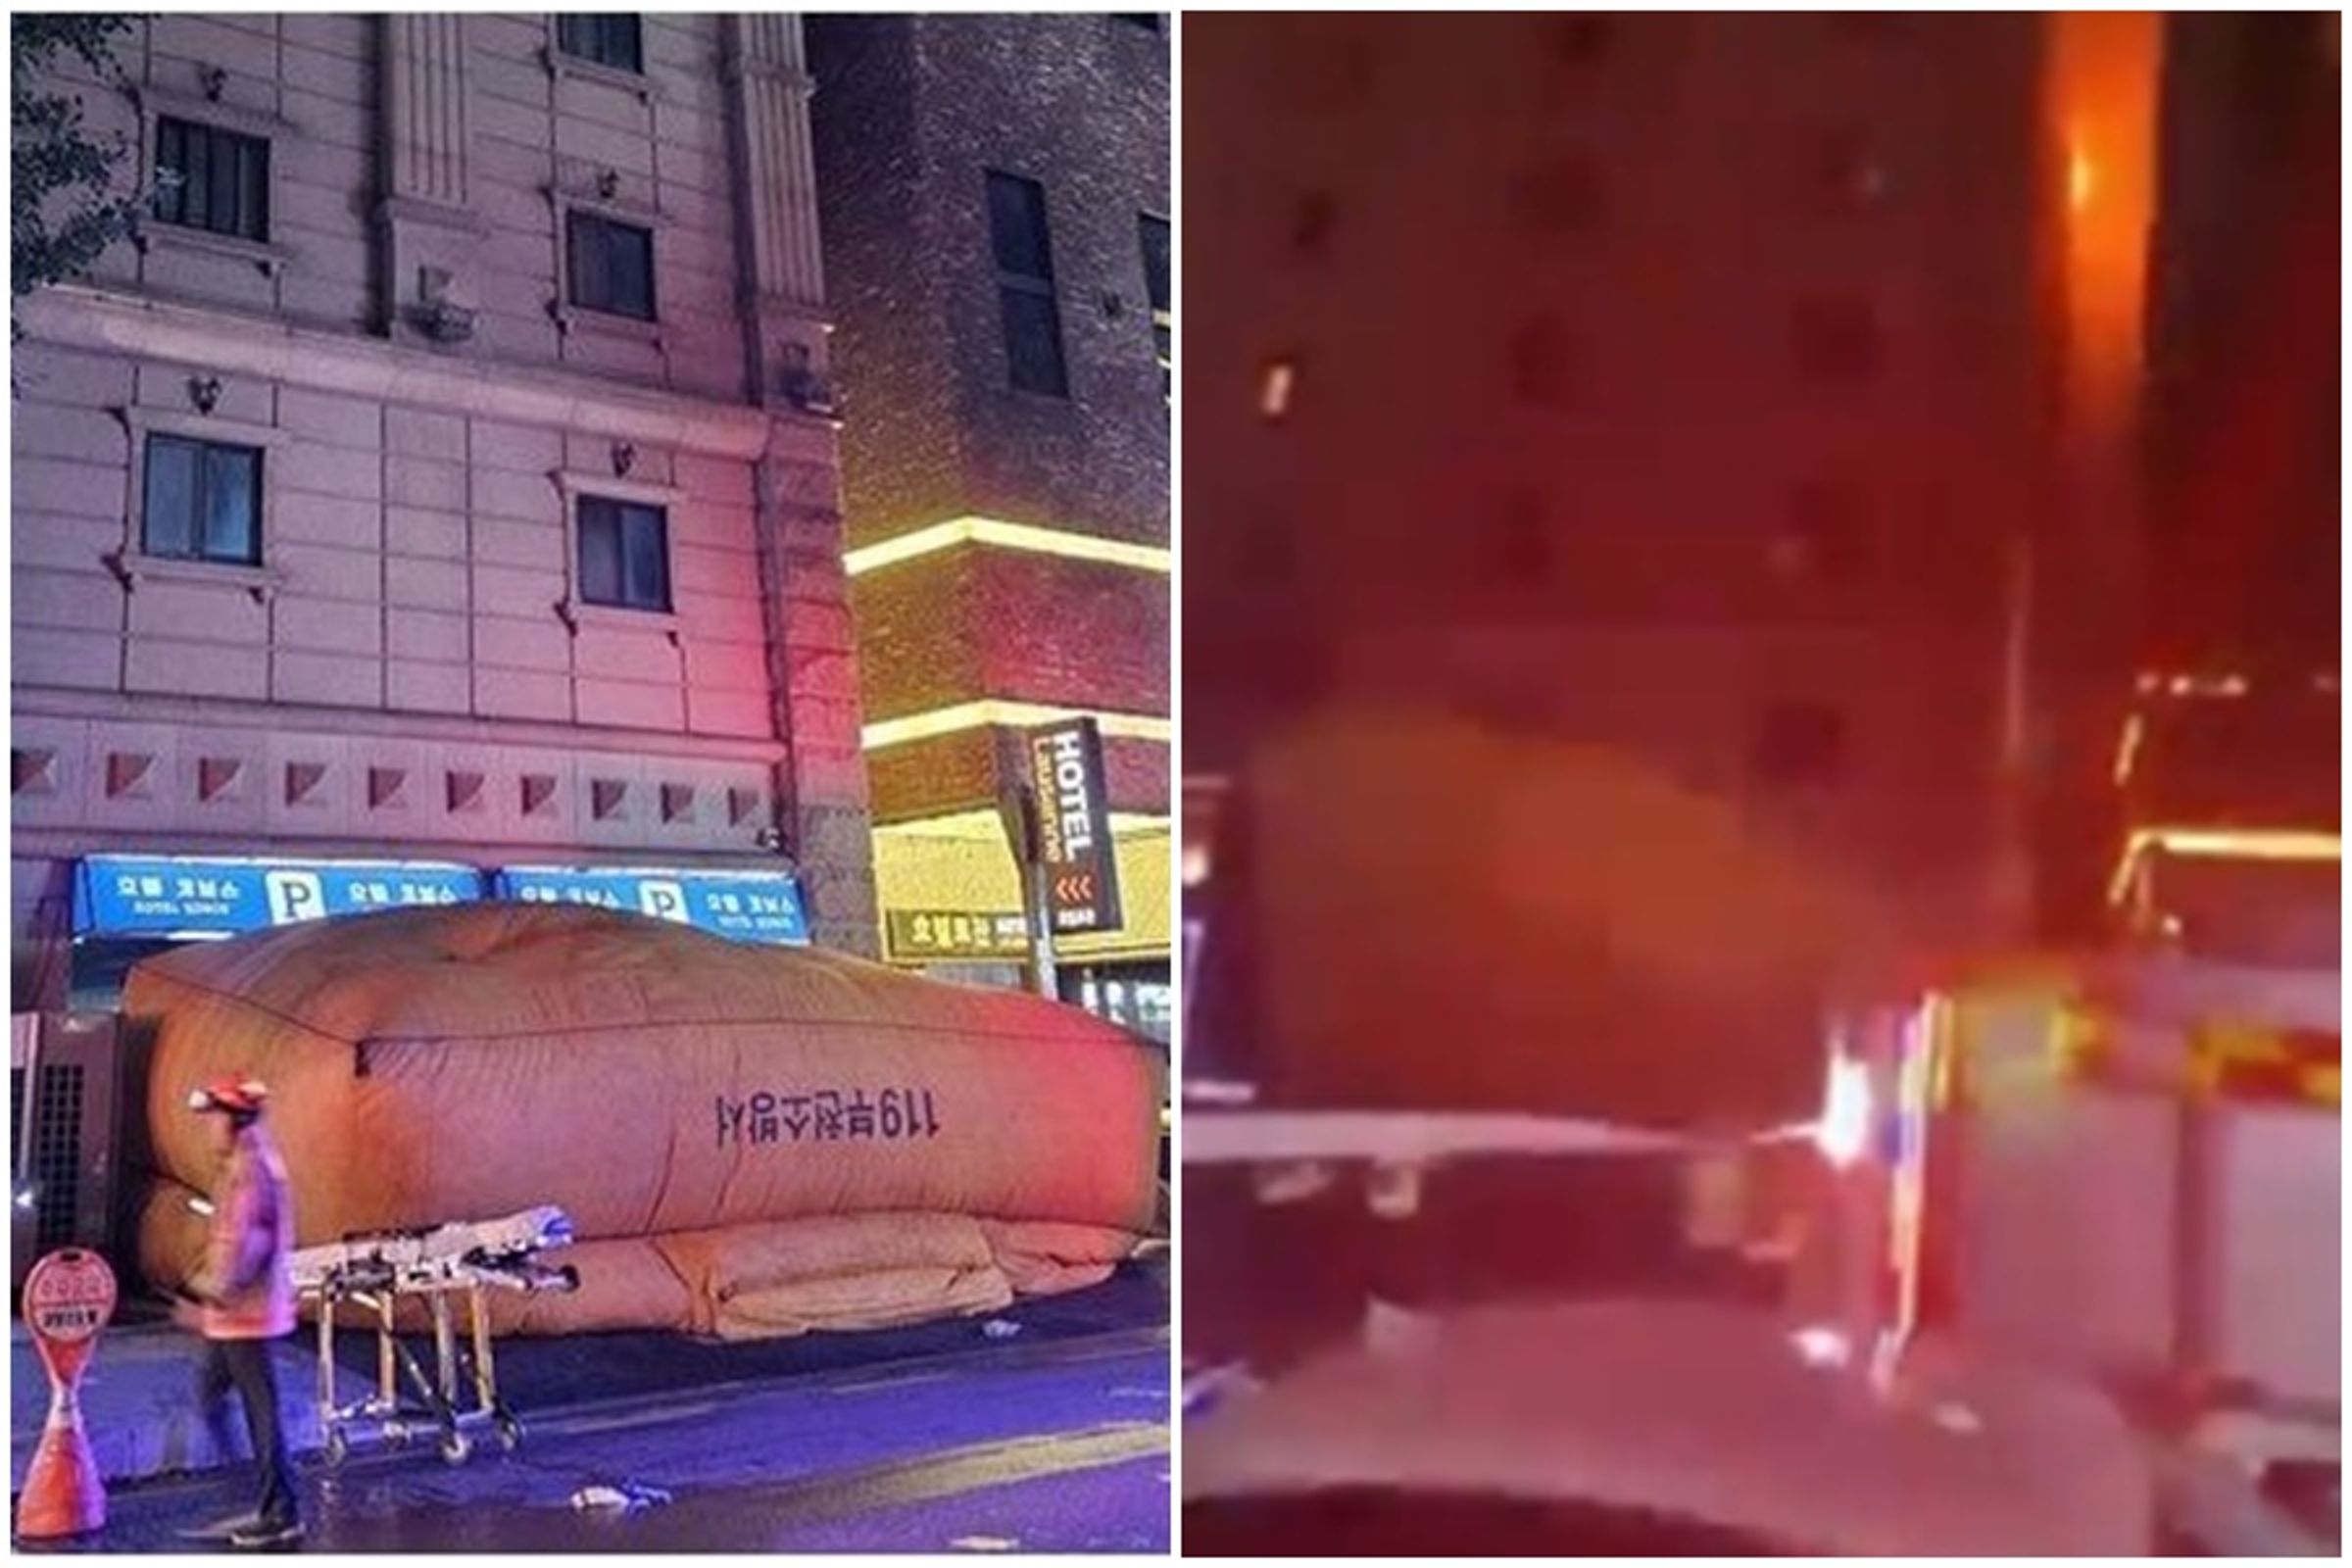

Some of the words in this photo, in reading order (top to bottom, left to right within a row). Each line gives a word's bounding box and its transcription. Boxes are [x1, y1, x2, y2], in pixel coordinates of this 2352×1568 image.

[1054, 731, 1093, 862] HOTEL
[281, 881, 311, 918] P
[650, 891, 676, 913] P
